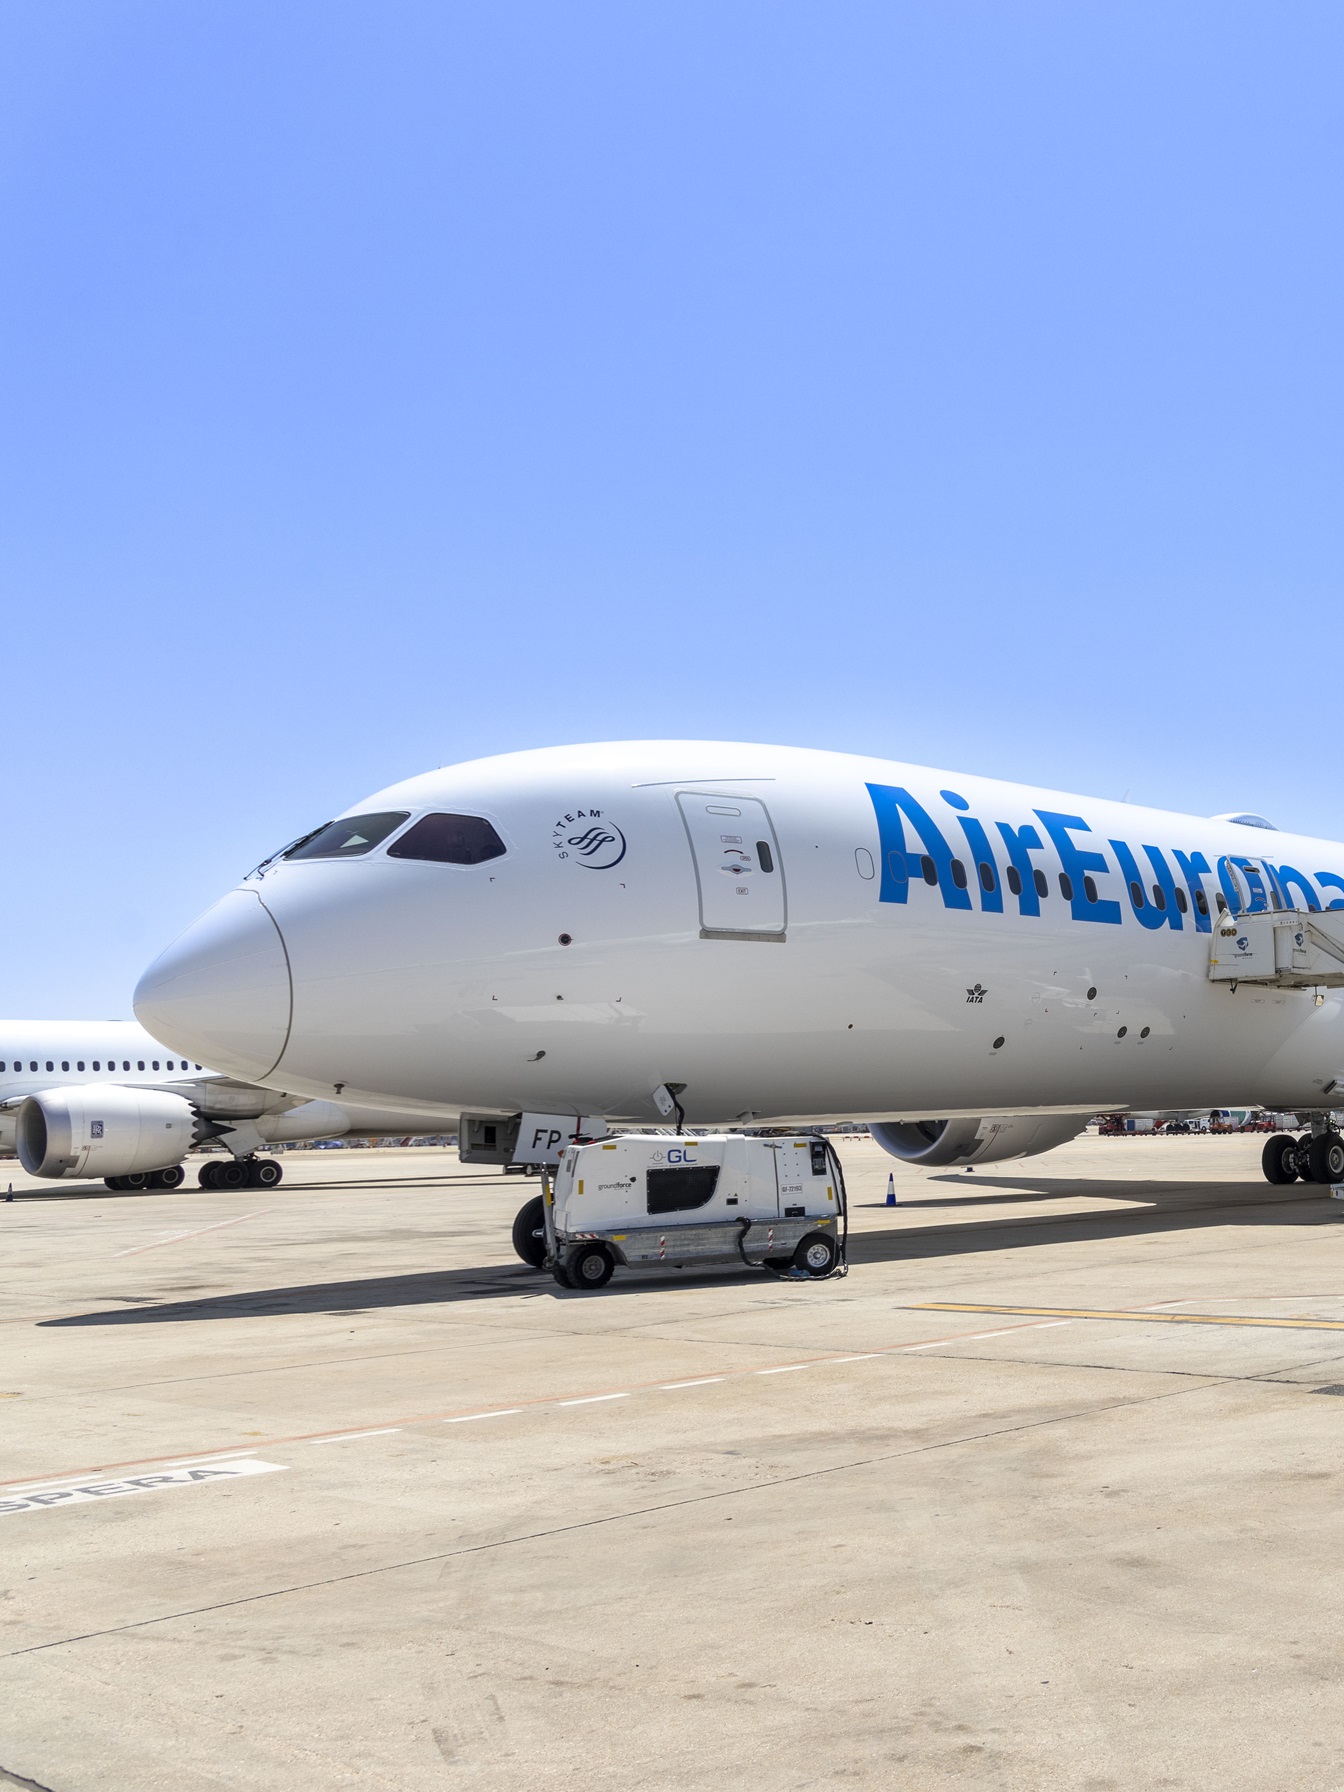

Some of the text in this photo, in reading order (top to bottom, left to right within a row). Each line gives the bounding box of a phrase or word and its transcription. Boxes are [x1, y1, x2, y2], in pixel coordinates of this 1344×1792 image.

[532, 1129, 562, 1149] FP
[667, 1149, 698, 1163] GL
[598, 1182, 632, 1191] groundforce
